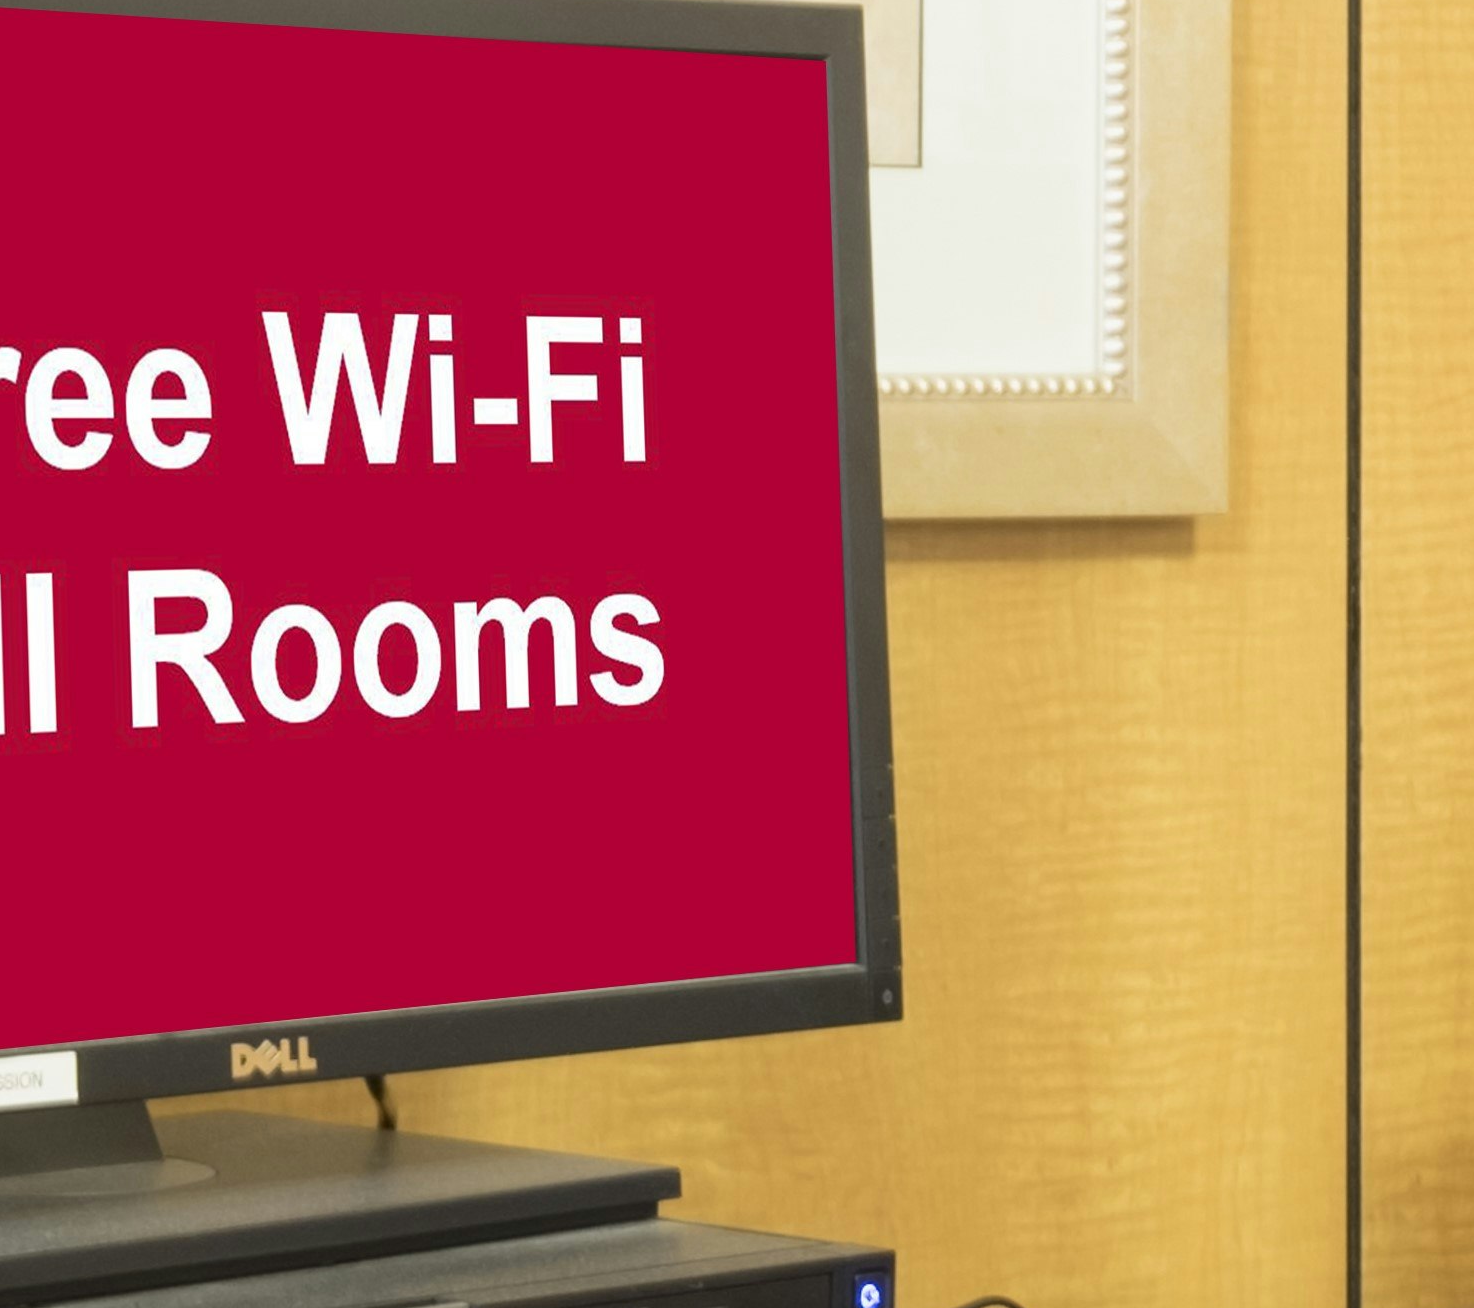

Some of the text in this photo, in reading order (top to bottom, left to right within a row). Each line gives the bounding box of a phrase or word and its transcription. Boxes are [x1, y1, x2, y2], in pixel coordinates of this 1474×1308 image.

[261, 311, 646, 465] Wi-Fi
[127, 569, 665, 728] Rooms
[230, 1036, 318, 1079] DELL
